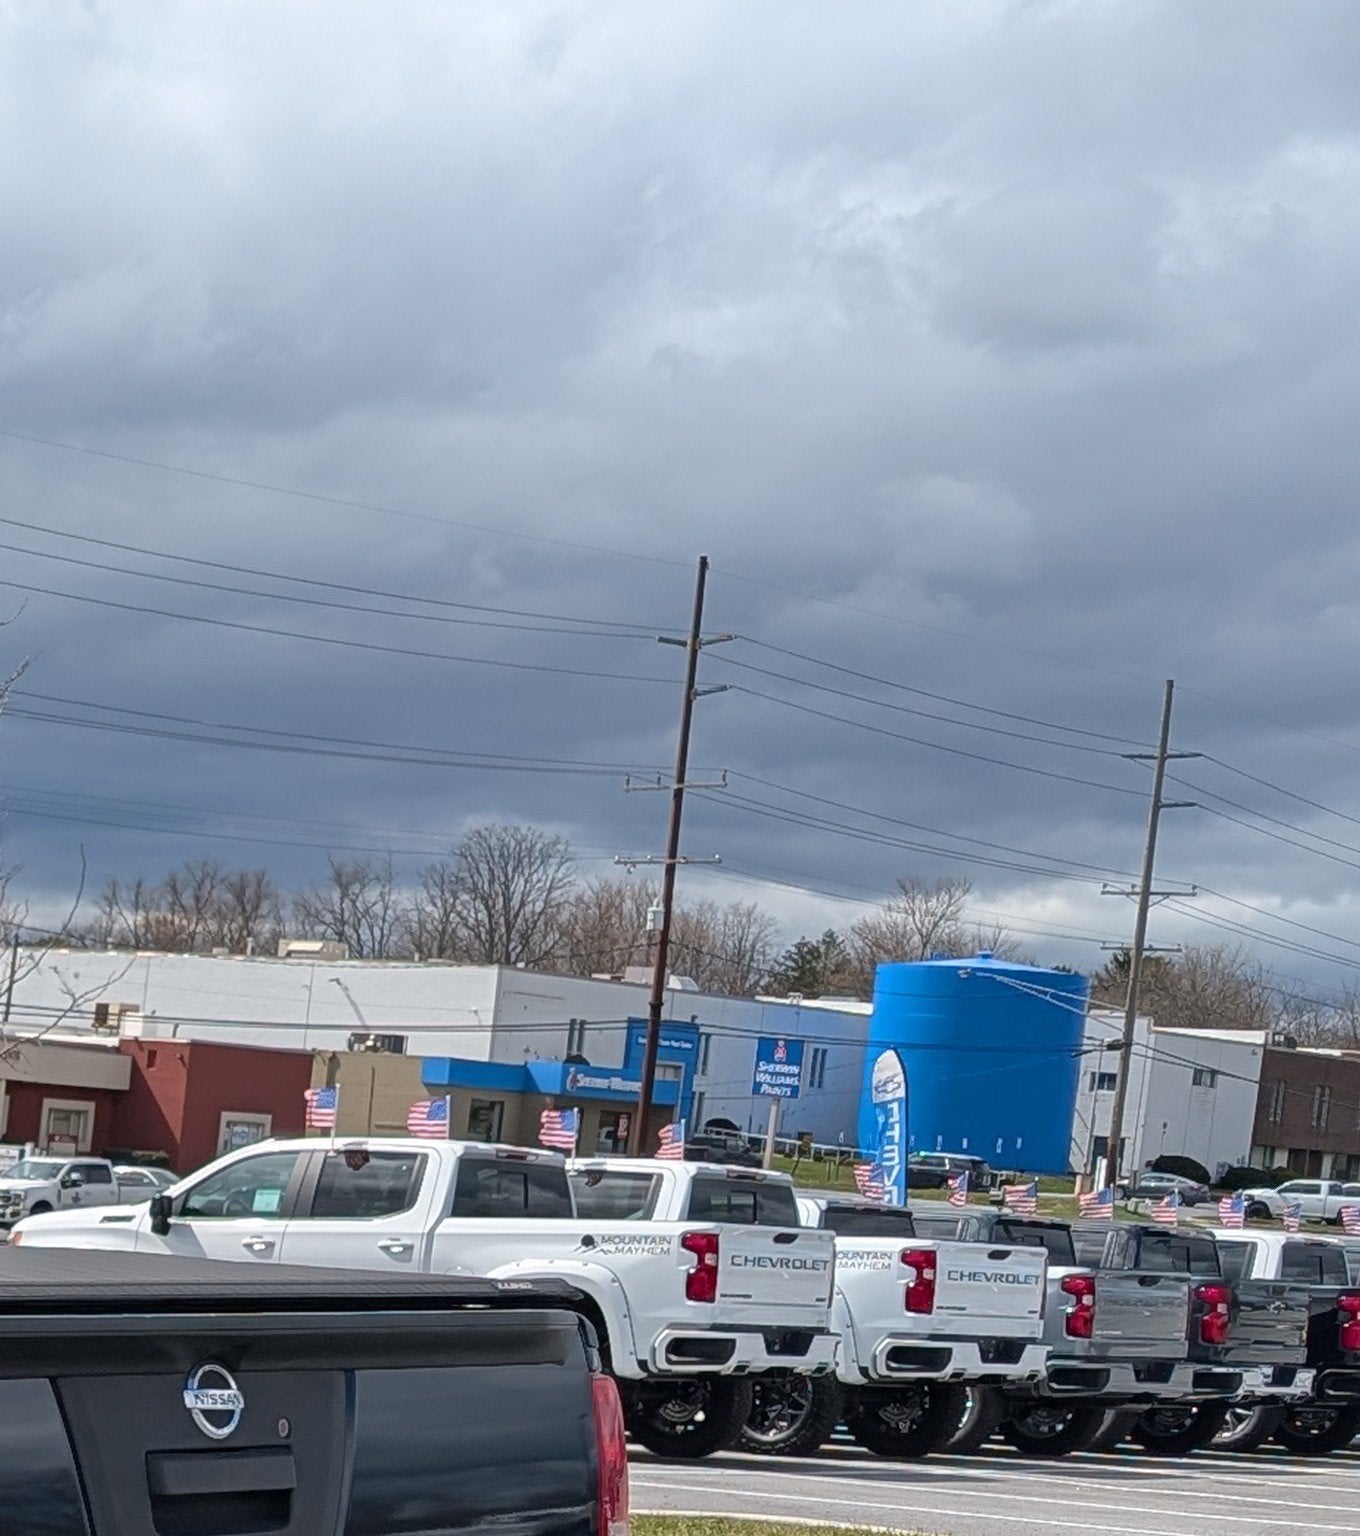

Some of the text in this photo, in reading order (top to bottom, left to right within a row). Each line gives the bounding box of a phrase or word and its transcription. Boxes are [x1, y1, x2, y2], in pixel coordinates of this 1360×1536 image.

[600, 1234, 672, 1246] MOUNTAIN
[614, 1246, 671, 1256] MAYHEM
[837, 1250, 893, 1261] OUNTAIN
[730, 1254, 830, 1272] CHEVROLET
[837, 1260, 893, 1271] MAYHEM
[947, 1270, 1041, 1286] CHEVROLET
[194, 1393, 242, 1406] NISSAN
